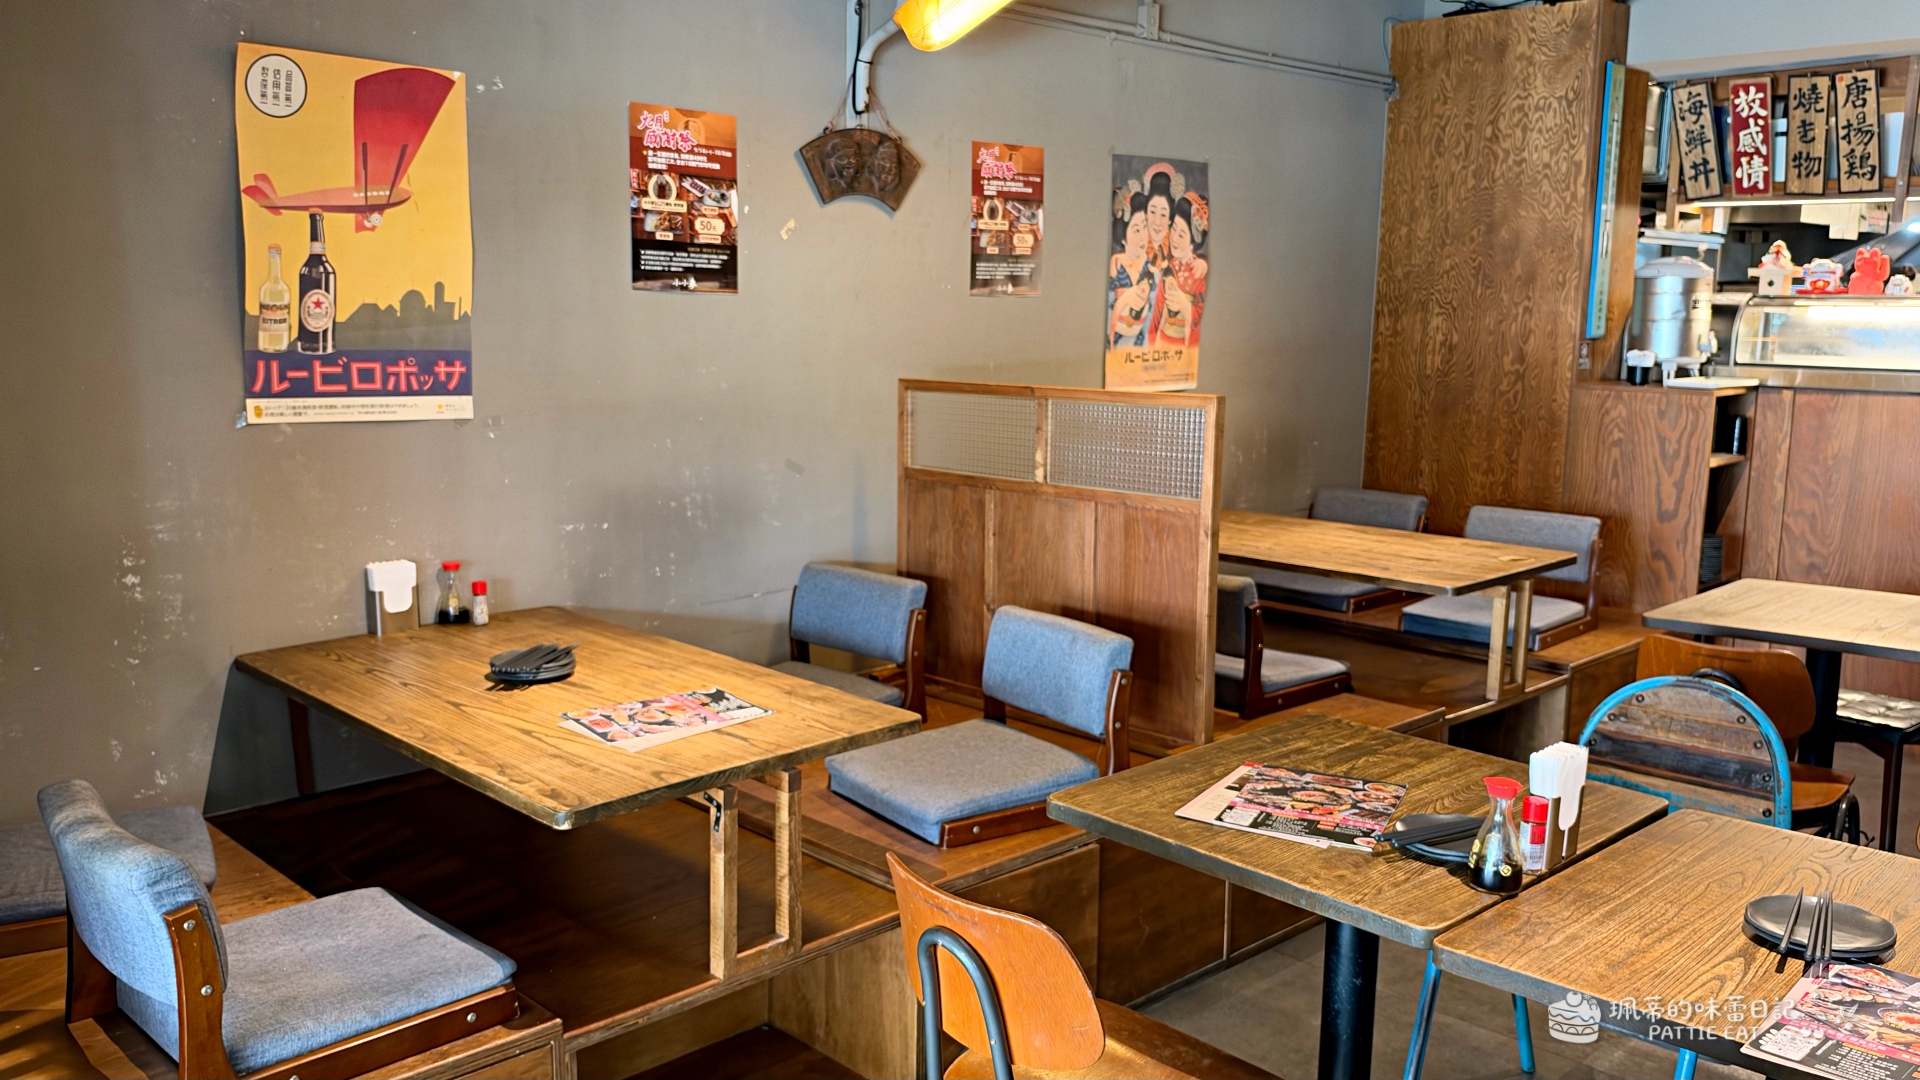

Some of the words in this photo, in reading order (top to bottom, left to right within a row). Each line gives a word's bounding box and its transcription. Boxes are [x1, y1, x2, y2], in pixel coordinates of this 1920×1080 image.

[1678, 90, 1715, 190] 海鮮丼
[1734, 85, 1768, 190] 放感情
[1841, 76, 1876, 182] 唐揚鶏
[251, 357, 467, 394] ルービロポッサ
